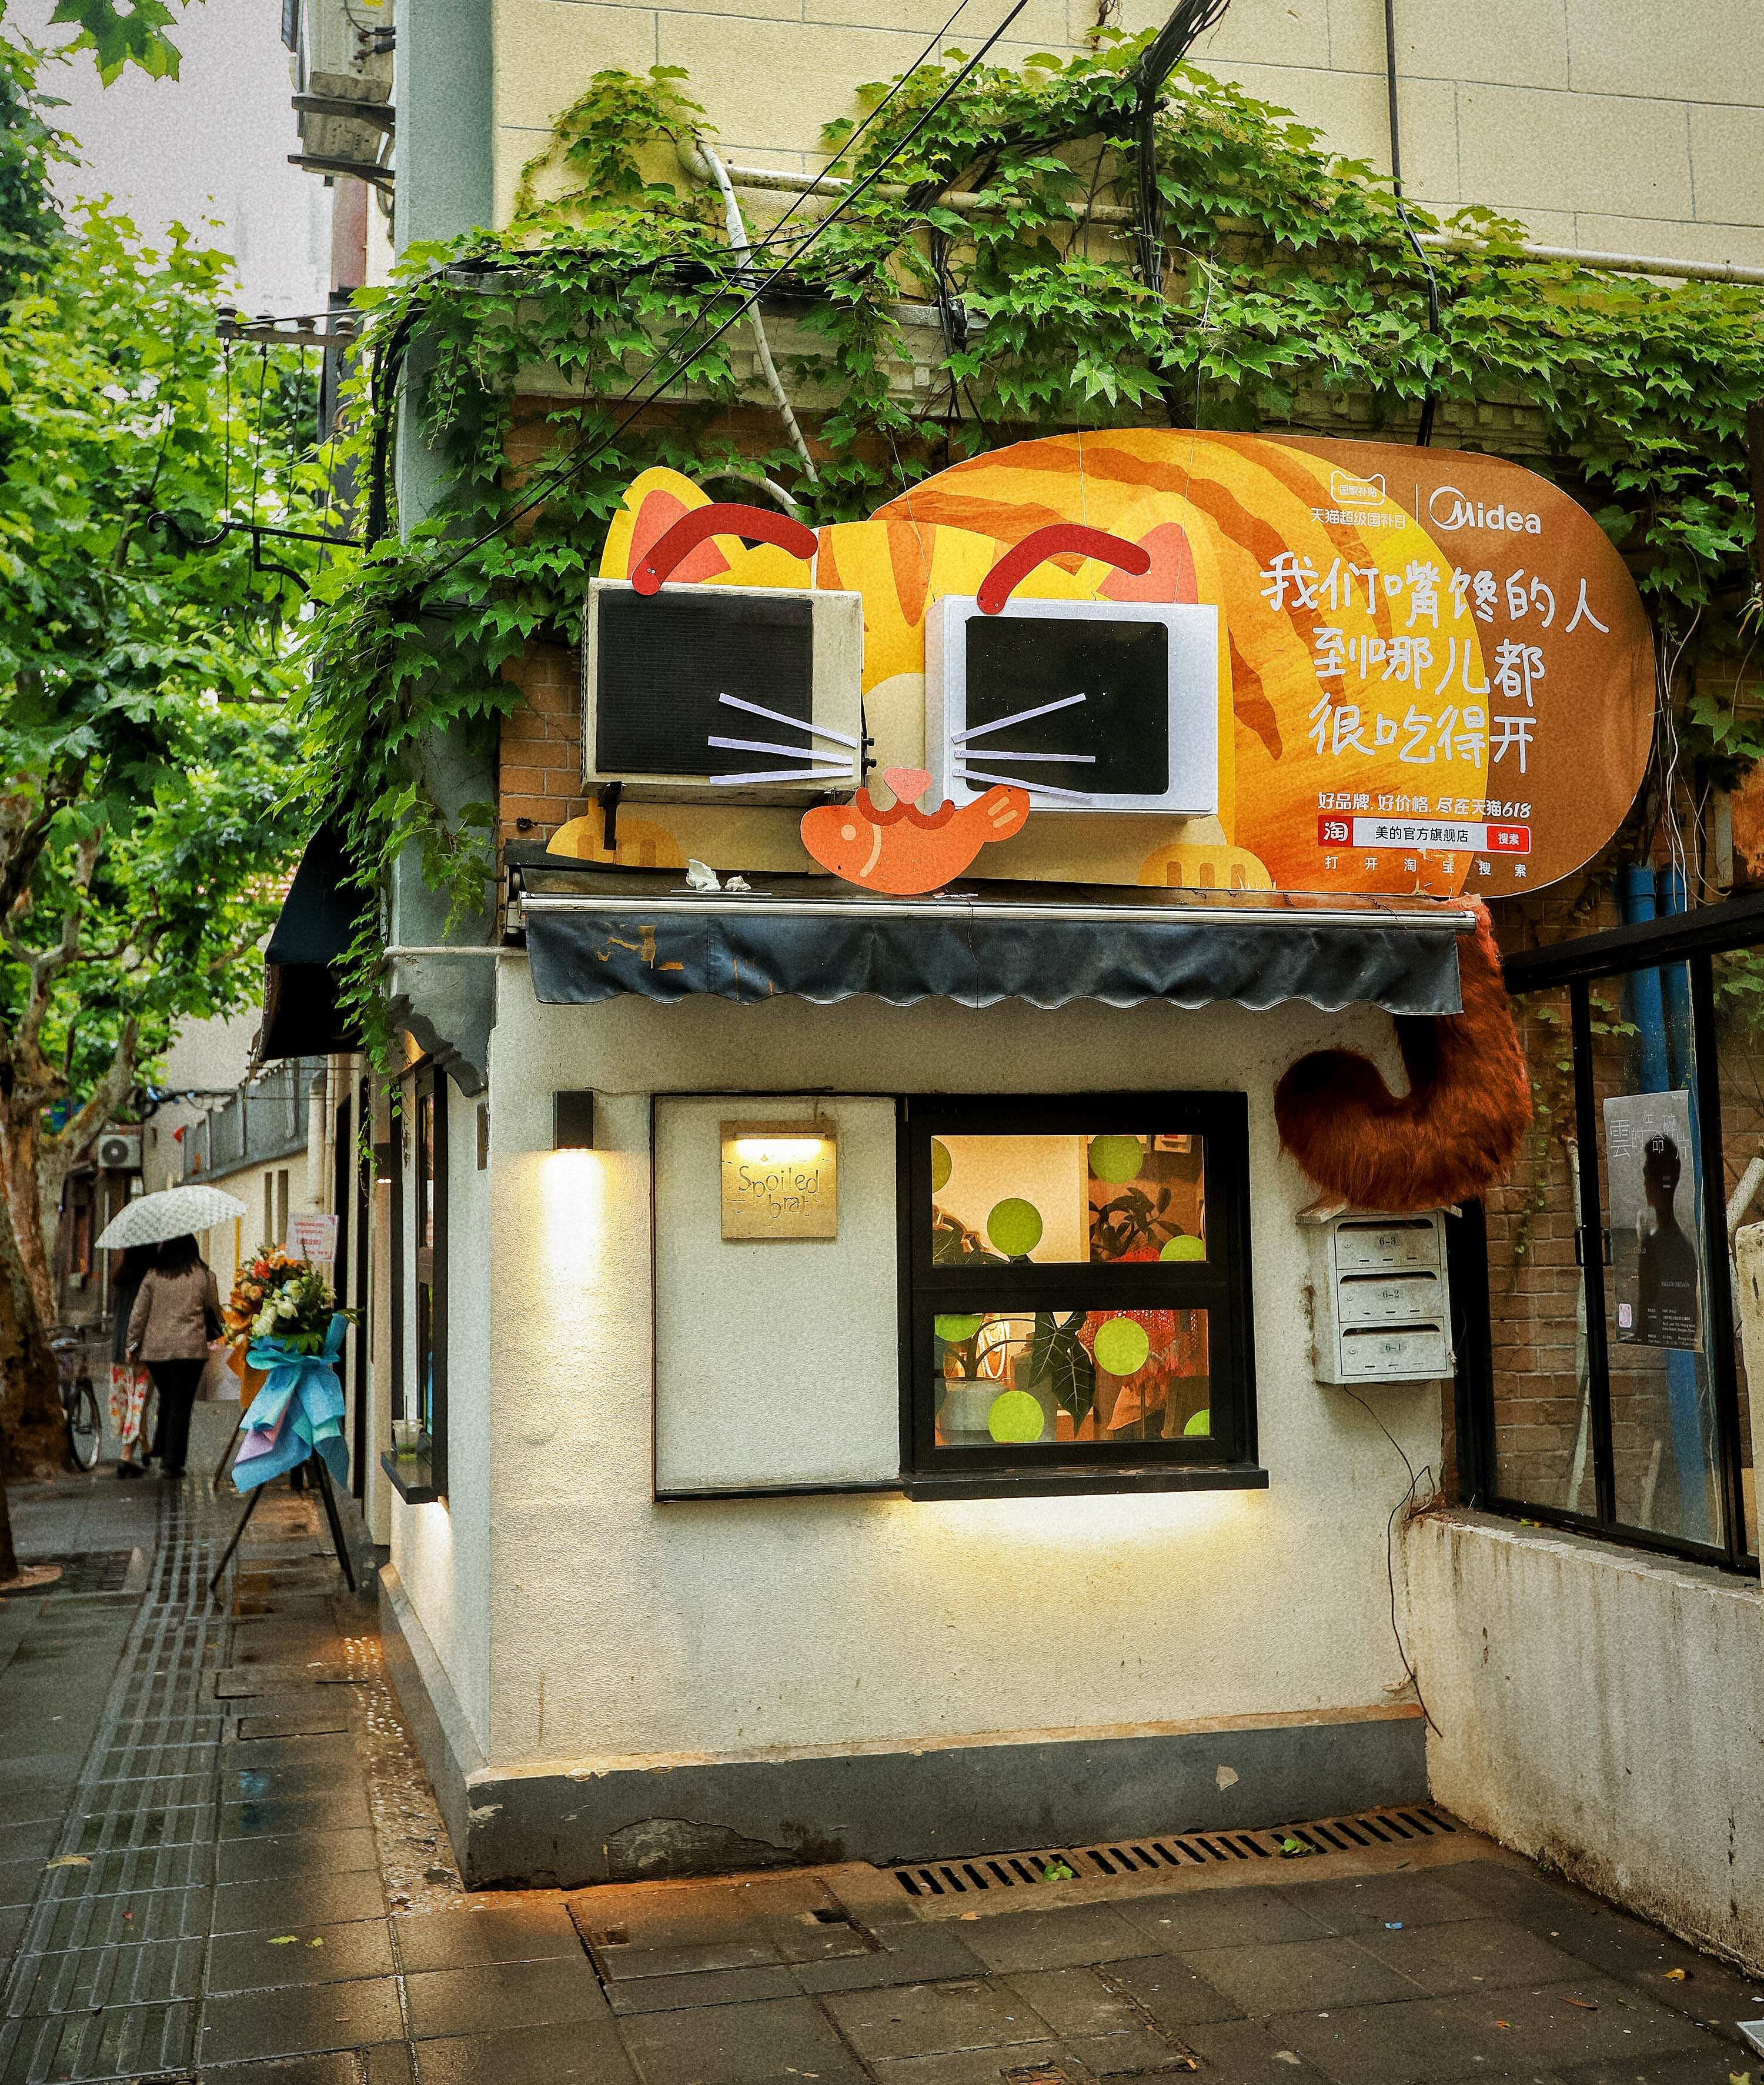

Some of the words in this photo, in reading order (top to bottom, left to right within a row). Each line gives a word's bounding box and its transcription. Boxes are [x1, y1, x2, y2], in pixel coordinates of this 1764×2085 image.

[1339, 484, 1377, 498] 国家补贴
[1309, 507, 1406, 529] 天猫超级国补日
[1439, 499, 1541, 535] Midea
[1259, 551, 1610, 633] 我们嘴馋的人
[1312, 627, 1546, 708] 到哪儿都
[1308, 692, 1537, 774] 很吃得开
[1322, 820, 1349, 841] 淘
[1375, 825, 1469, 843] 美的官方旗舰店
[1498, 832, 1520, 846] 搜索
[738, 1165, 820, 1198] Spoiled
[768, 1193, 810, 1219] brat
[1379, 1237, 1397, 1246] 6-3
[1382, 1289, 1400, 1299] 6-2
[1385, 1342, 1402, 1352] 6-1
